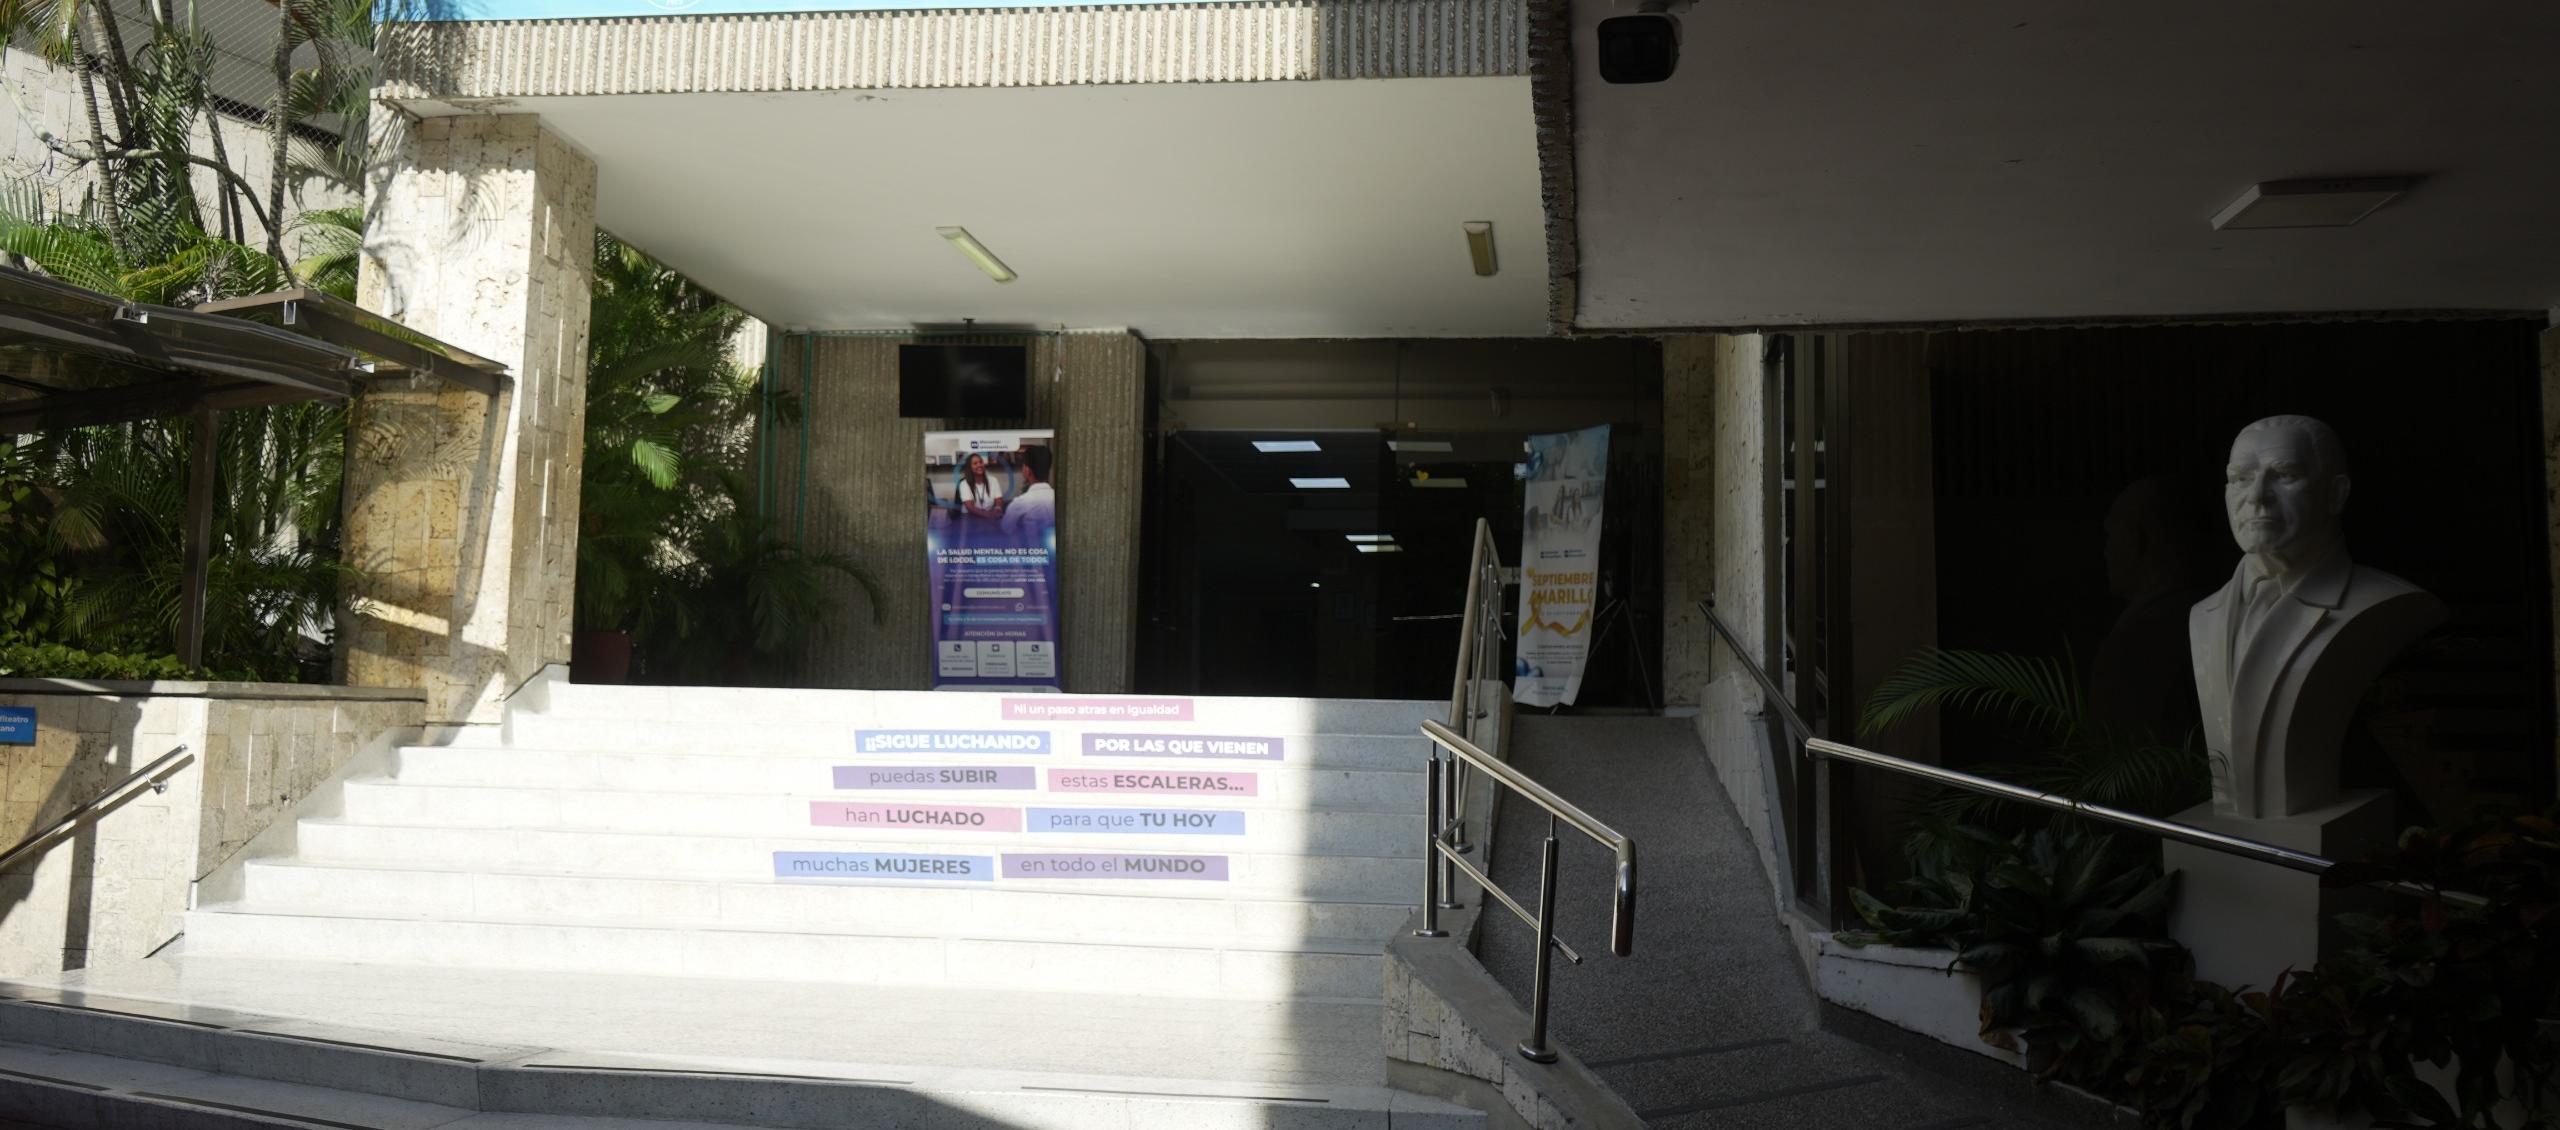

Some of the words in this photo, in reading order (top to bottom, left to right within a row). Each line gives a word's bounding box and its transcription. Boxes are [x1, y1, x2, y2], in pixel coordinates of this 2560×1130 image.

[936, 548, 948, 556] LA
[947, 548, 973, 556] SALUD
[973, 548, 1003, 556] MENTAL
[1004, 548, 1017, 556] NO
[1018, 548, 1027, 556] ES
[1028, 548, 1049, 556] COSA
[936, 556, 948, 564] DE
[976, 556, 986, 564] ES
[987, 556, 1008, 564] COSA
[1009, 556, 1021, 564] DE
[1532, 572, 1595, 587] SEPTIEMBRE
[1013, 704, 1026, 714] Ni
[1029, 706, 1045, 715] un
[1046, 706, 1076, 717] paso
[1077, 705, 1108, 715] atras
[1109, 706, 1125, 715] en
[935, 735, 1041, 750] LUCHANDO
[1094, 738, 1131, 752] POR
[1133, 739, 1165, 753] LAS
[1168, 740, 1204, 754] QUE
[1206, 741, 1269, 755] VIENEN
[869, 770, 935, 785] puedas
[940, 769, 998, 784] SUBIR
[1061, 776, 1108, 788] estas
[1113, 774, 1244, 792] ESCALERAS...
[845, 807, 880, 822] han
[886, 810, 985, 826] LUCHADO
[1050, 814, 1092, 828] para
[1098, 815, 1135, 829] que
[1140, 812, 1167, 827] TU
[1173, 813, 1217, 828] HOY
[792, 856, 870, 872] muchas
[875, 858, 971, 875] MUJERES
[1021, 861, 1045, 873] en
[1050, 857, 1096, 872] todo
[1101, 857, 1118, 872] el
[1124, 858, 1206, 874] MUNDO
